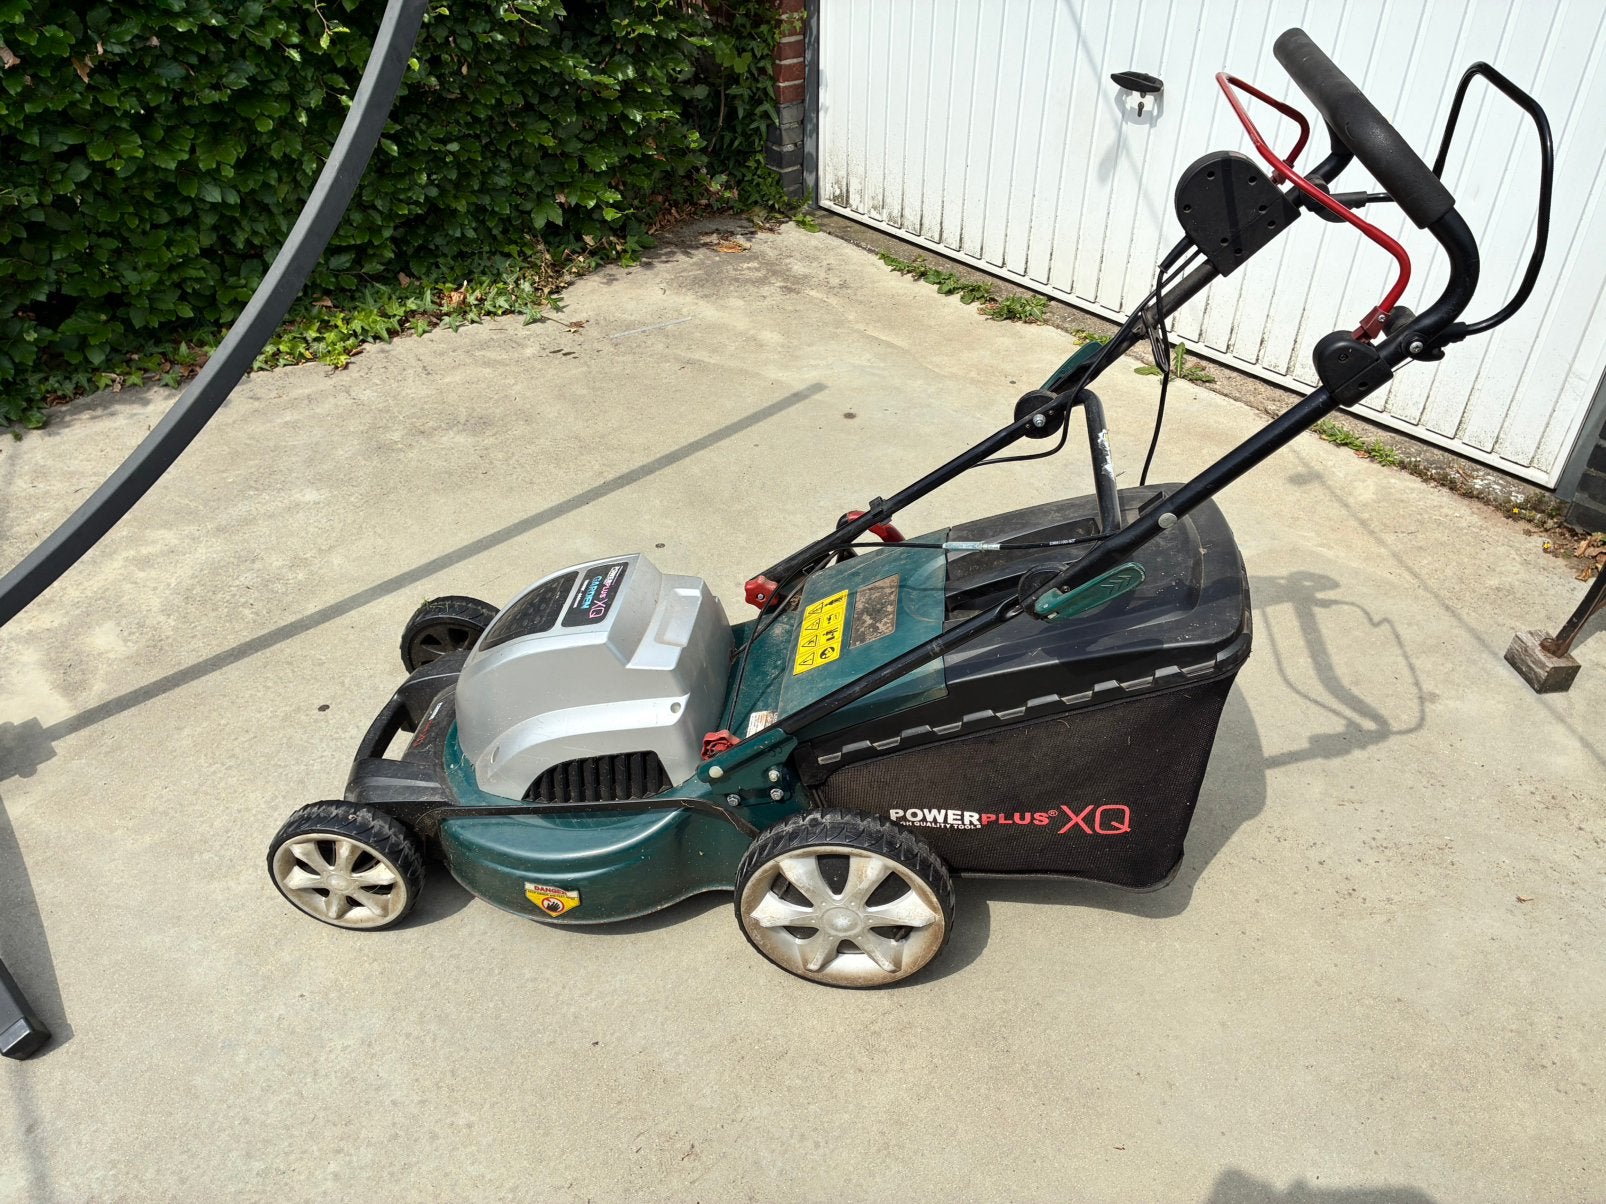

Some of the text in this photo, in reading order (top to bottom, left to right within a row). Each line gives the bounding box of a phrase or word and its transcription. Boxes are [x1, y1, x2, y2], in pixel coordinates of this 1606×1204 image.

[581, 575, 602, 609] GARDEN
[589, 599, 608, 618] XQ
[1057, 804, 1131, 834] XQ
